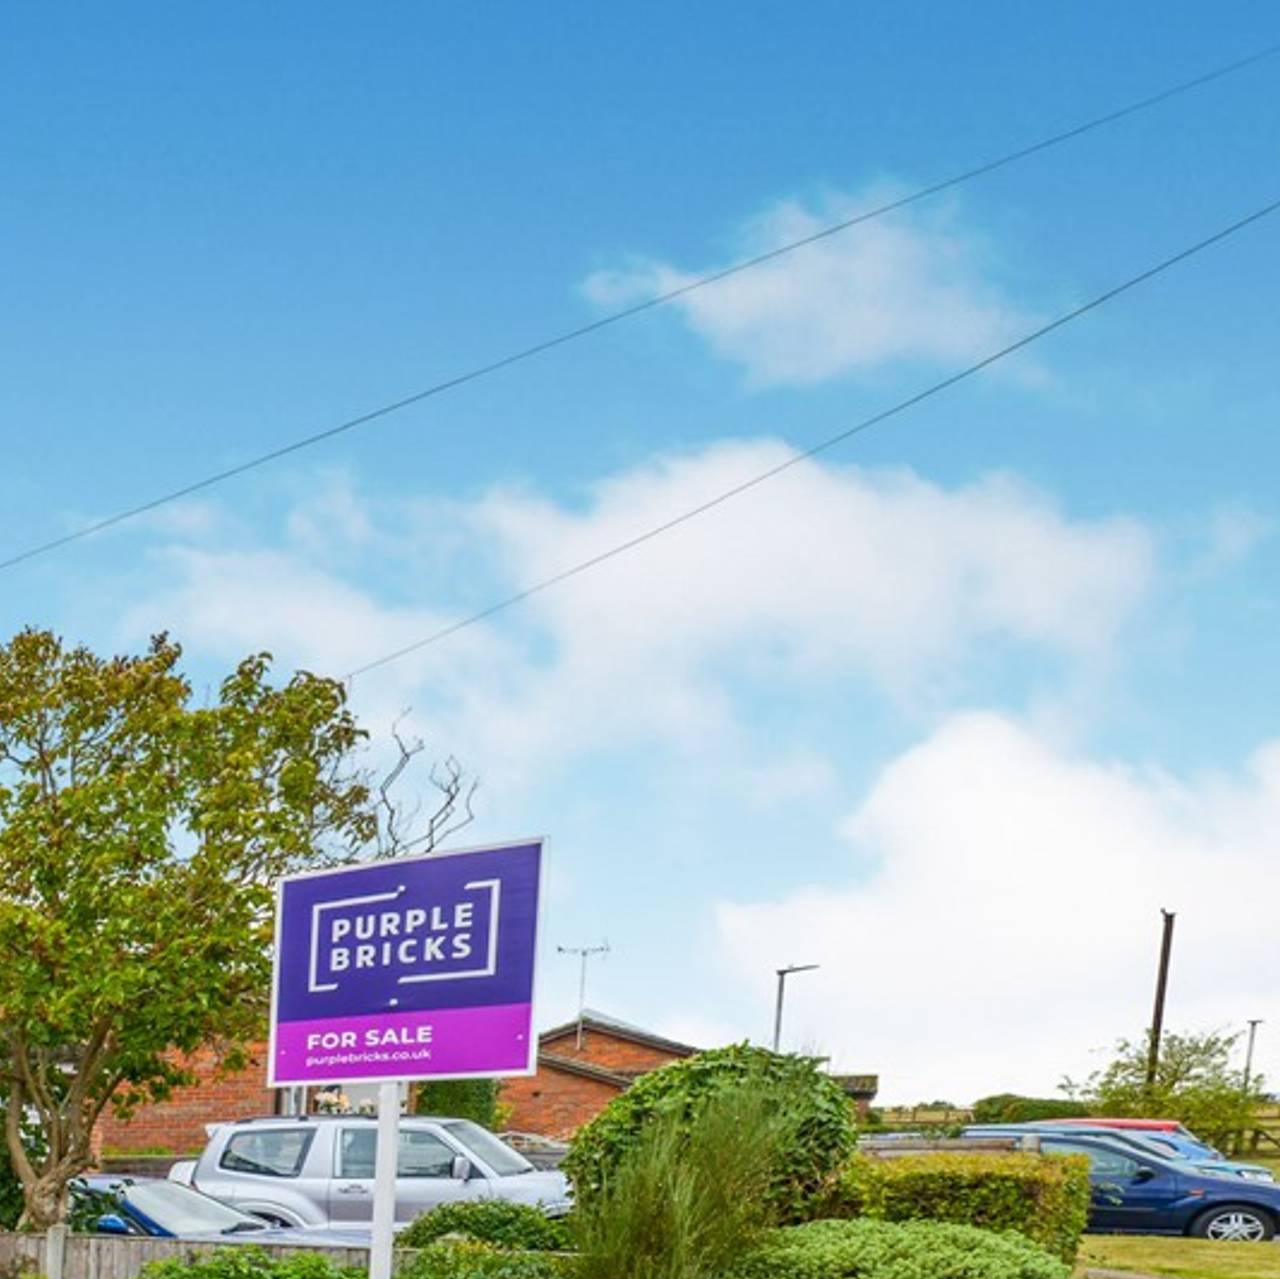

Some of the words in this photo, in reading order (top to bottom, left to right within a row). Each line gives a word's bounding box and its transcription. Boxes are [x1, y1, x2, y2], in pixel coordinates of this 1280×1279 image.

[332, 902, 473, 942] PURPLE
[330, 933, 471, 971] BRICKS
[307, 1032, 357, 1050] FOR
[365, 1025, 433, 1046] SALE
[305, 1049, 431, 1067] purplebricks.co.uk
